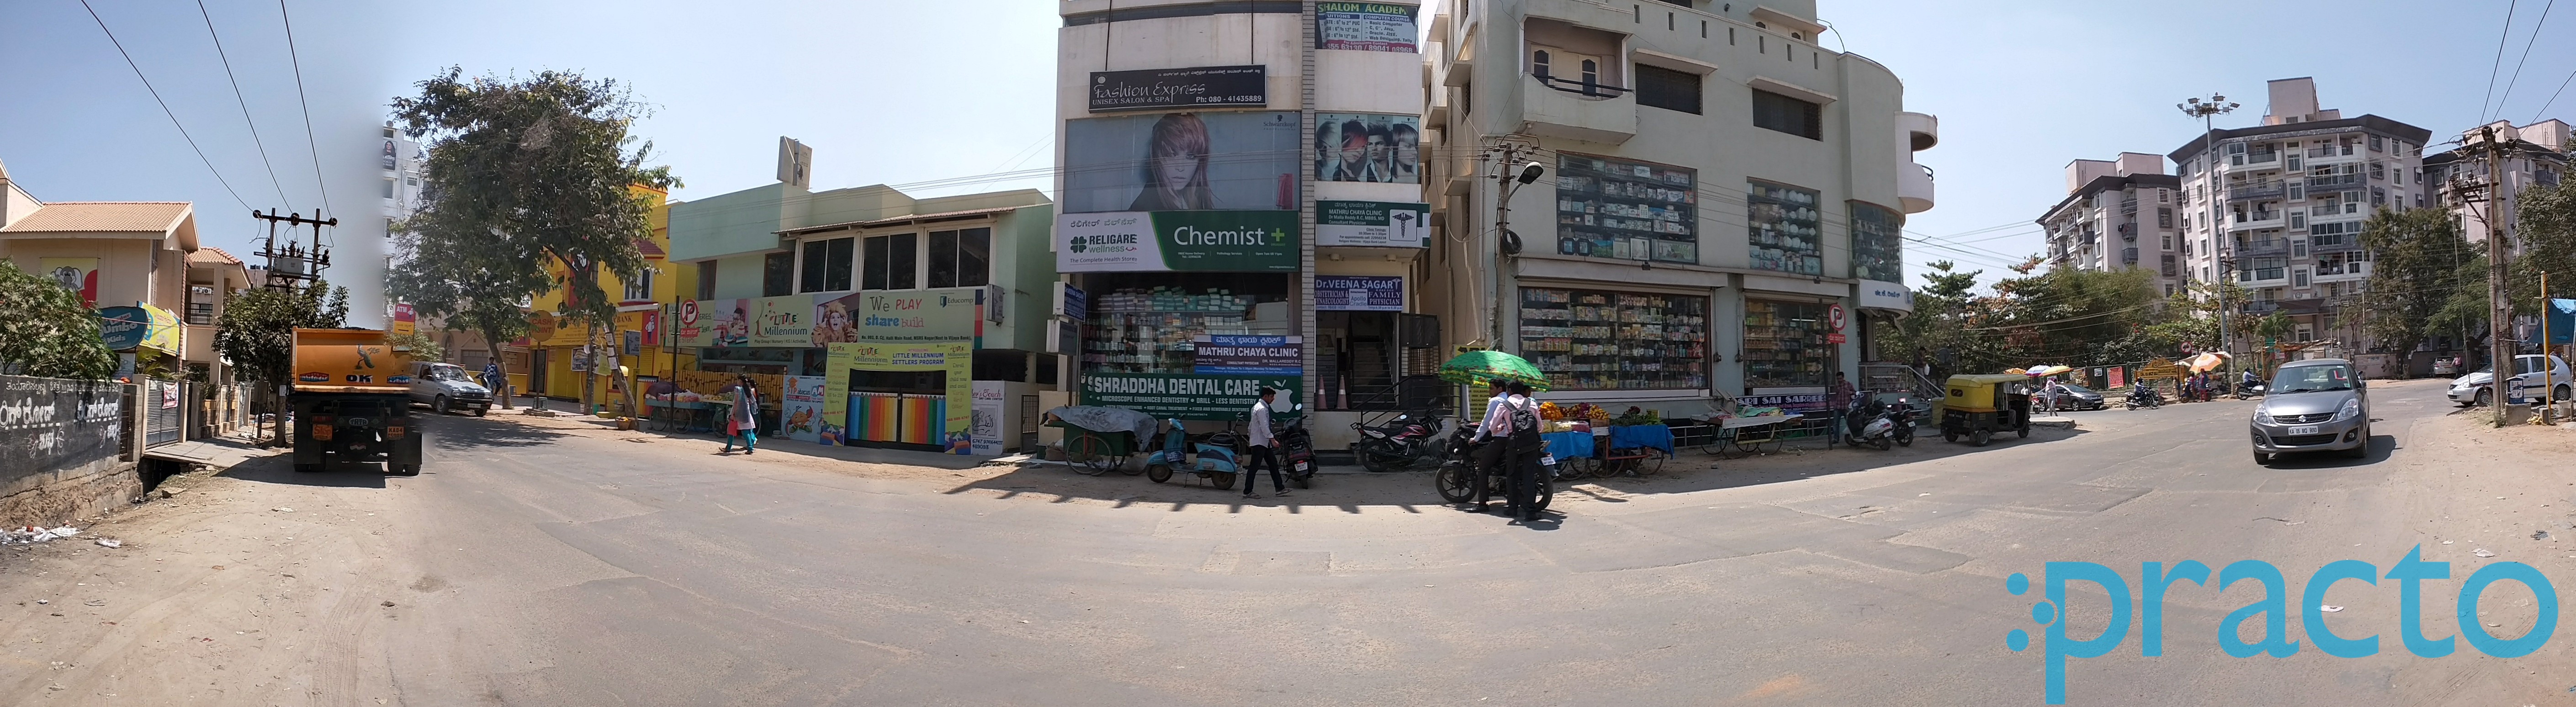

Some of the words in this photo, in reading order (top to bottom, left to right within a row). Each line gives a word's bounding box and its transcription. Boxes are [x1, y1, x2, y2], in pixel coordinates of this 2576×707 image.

[1318, 3, 1359, 13] SHALOM
[1093, 81, 1149, 98] Fashion
[1174, 226, 1265, 246] Chemist
[1089, 245, 1124, 253] wellness
[1316, 280, 1360, 289] Dr.VEENA
[1362, 280, 1393, 289] SAGAR
[869, 296, 890, 312] We
[896, 299, 922, 311] PLAY
[773, 311, 799, 326] LITTLE
[865, 314, 899, 327] share
[901, 317, 924, 327] build
[764, 326, 807, 336] Millennium
[106, 335, 126, 343] Kids
[860, 346, 880, 356] LITTLE
[1198, 347, 1235, 356] MATHRU
[1237, 347, 1267, 357] CHAYA
[1268, 348, 1298, 357] CLINIC
[345, 374, 373, 384] OK
[1094, 377, 1166, 394] SHRADDHA
[1169, 379, 1221, 395] DENTAL
[1224, 380, 1259, 396] CARE
[982, 389, 1001, 397] Touch
[1762, 396, 1781, 405] SAI
